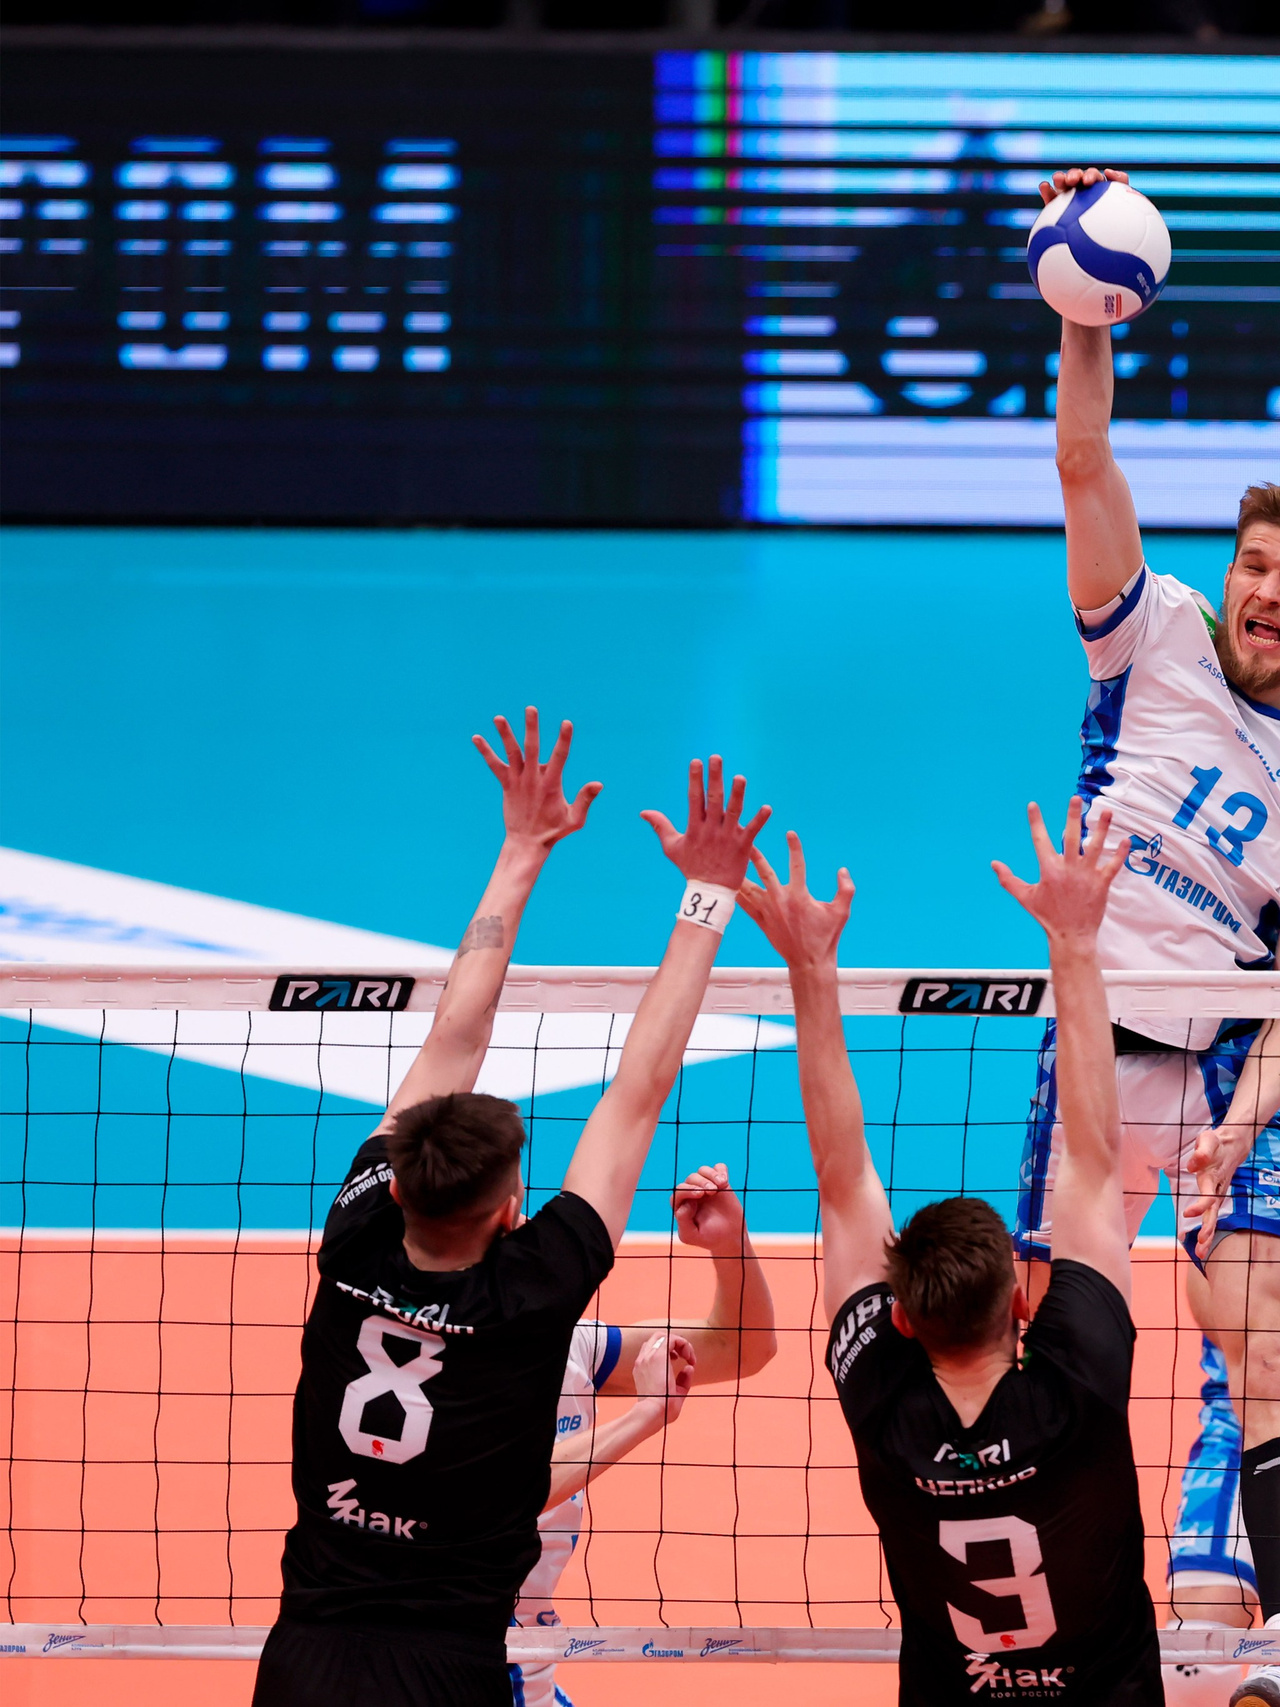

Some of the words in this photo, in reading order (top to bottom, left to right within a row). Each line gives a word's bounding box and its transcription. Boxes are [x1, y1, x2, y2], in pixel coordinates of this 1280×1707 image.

[1198, 656, 1230, 690] ZASPO
[1171, 765, 1269, 868] 13
[683, 892, 719, 926] 31
[281, 980, 401, 1008] PARI
[912, 982, 1033, 1012] PARI
[337, 1314, 447, 1465] 8
[556, 1415, 582, 1433] ФВ
[939, 1514, 1058, 1654] 3
[0, 1645, 26, 1653] АЗПРОМ
